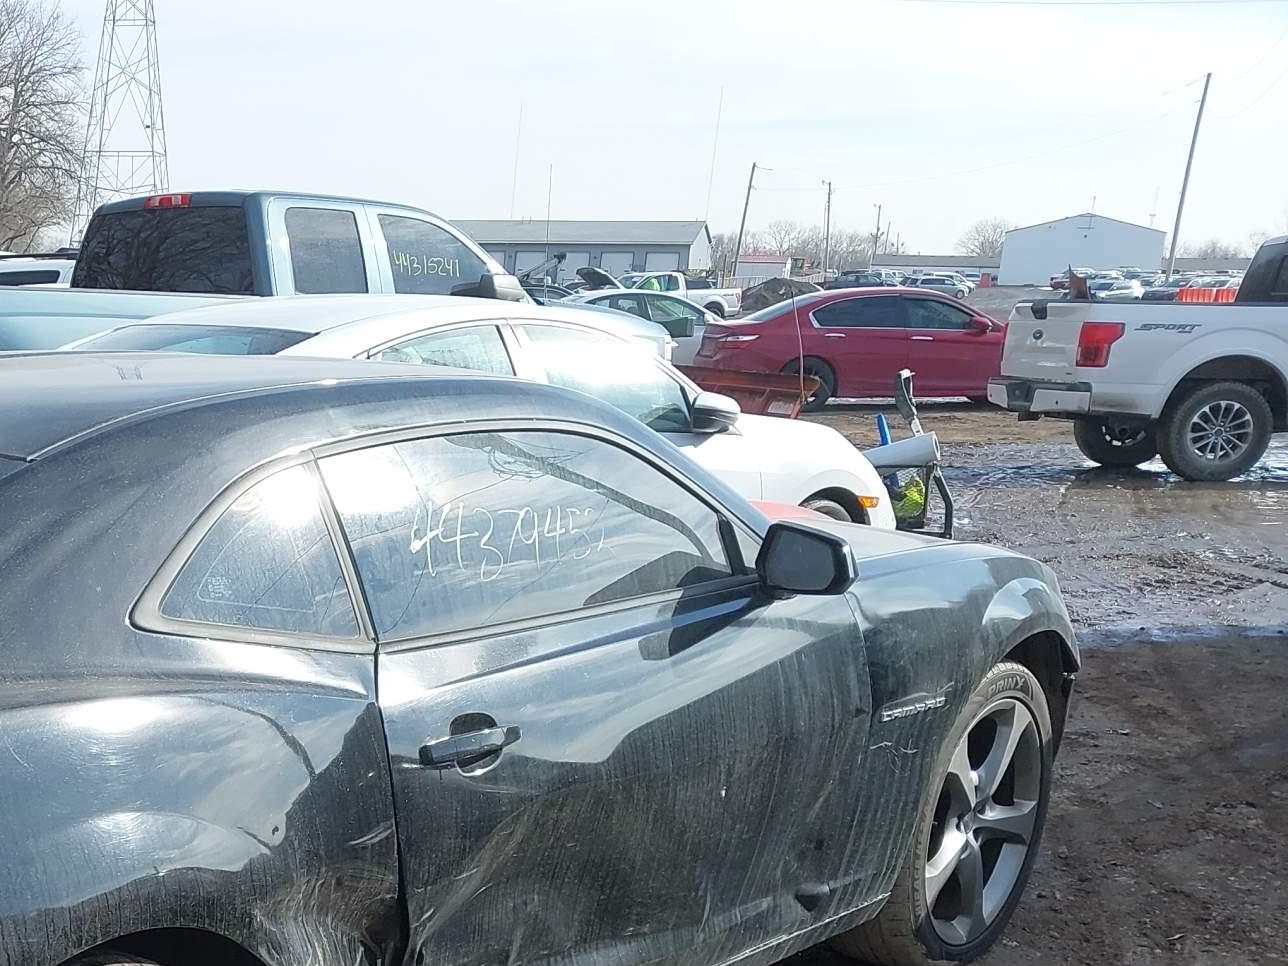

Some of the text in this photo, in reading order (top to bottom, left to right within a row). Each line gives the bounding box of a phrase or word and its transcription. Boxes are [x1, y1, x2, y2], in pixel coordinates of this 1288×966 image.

[393, 249, 460, 278] 44315241
[1134, 323, 1203, 332] SPORT
[881, 697, 947, 722] CAMARO
